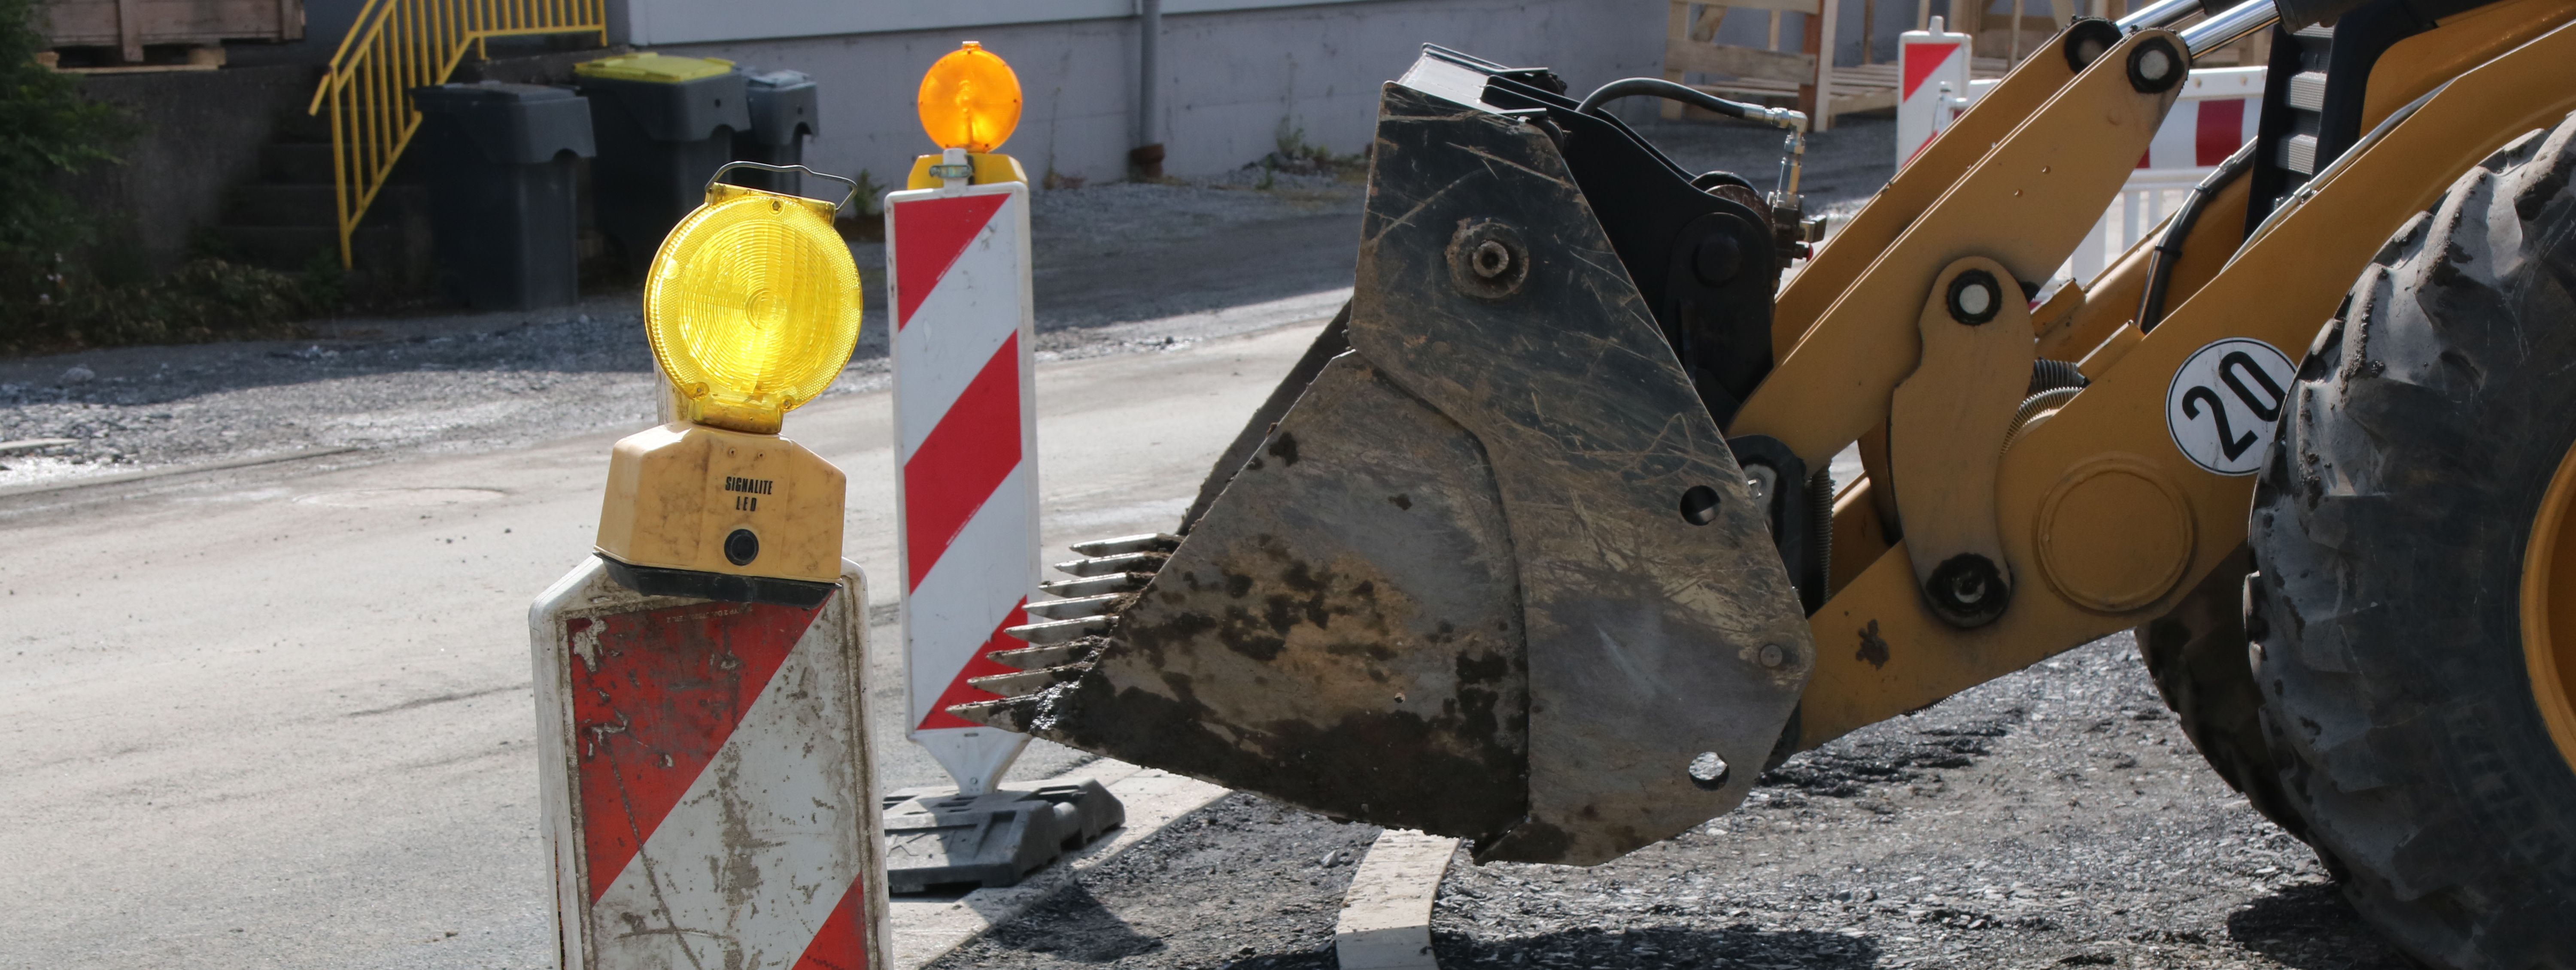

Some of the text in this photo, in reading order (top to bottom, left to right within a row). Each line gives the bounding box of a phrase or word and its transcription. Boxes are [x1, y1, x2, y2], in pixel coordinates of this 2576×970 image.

[2182, 351, 2286, 462] 20
[725, 476, 773, 494] SIGNALITE
[736, 496, 756, 511] LED
